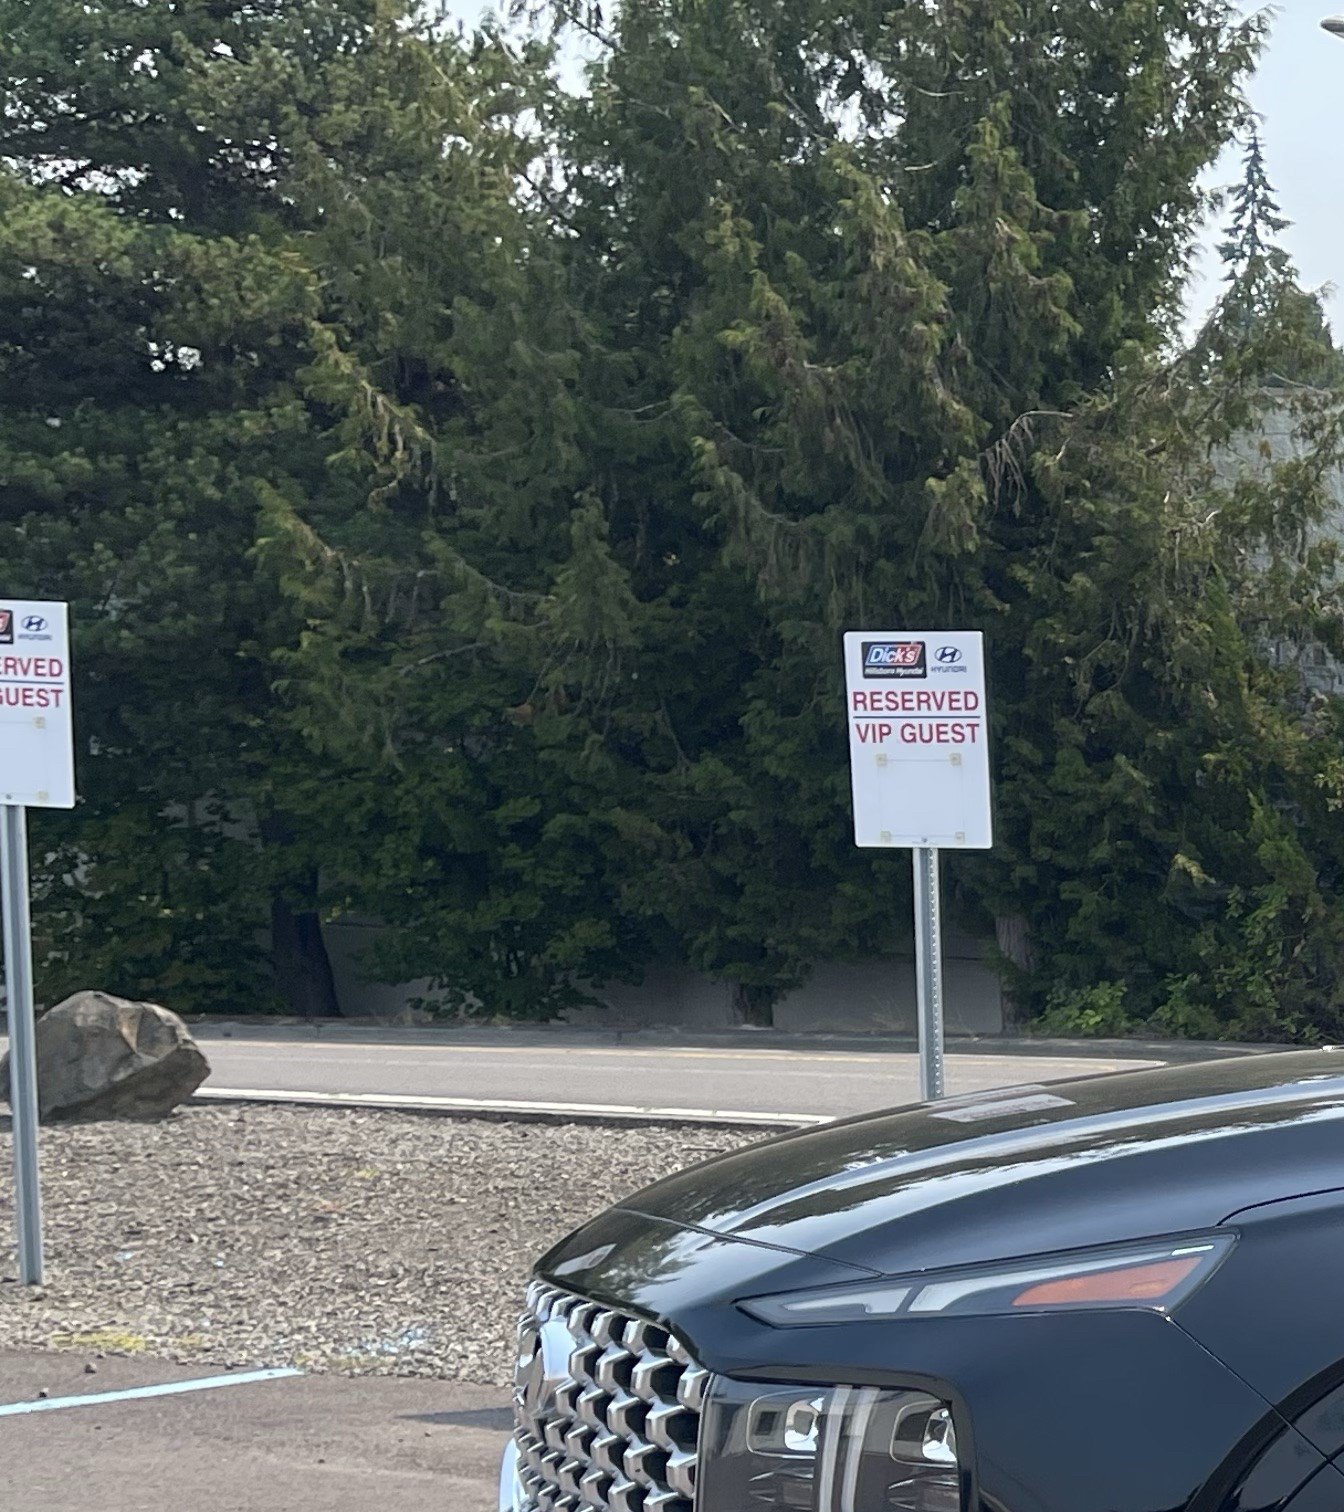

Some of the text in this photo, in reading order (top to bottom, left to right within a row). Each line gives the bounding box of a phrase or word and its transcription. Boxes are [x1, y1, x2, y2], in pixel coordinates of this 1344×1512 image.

[869, 647, 916, 663] Dick's
[0, 656, 63, 677] RVED
[853, 691, 979, 711] RESERVED
[855, 723, 980, 743] VIP GUEST
